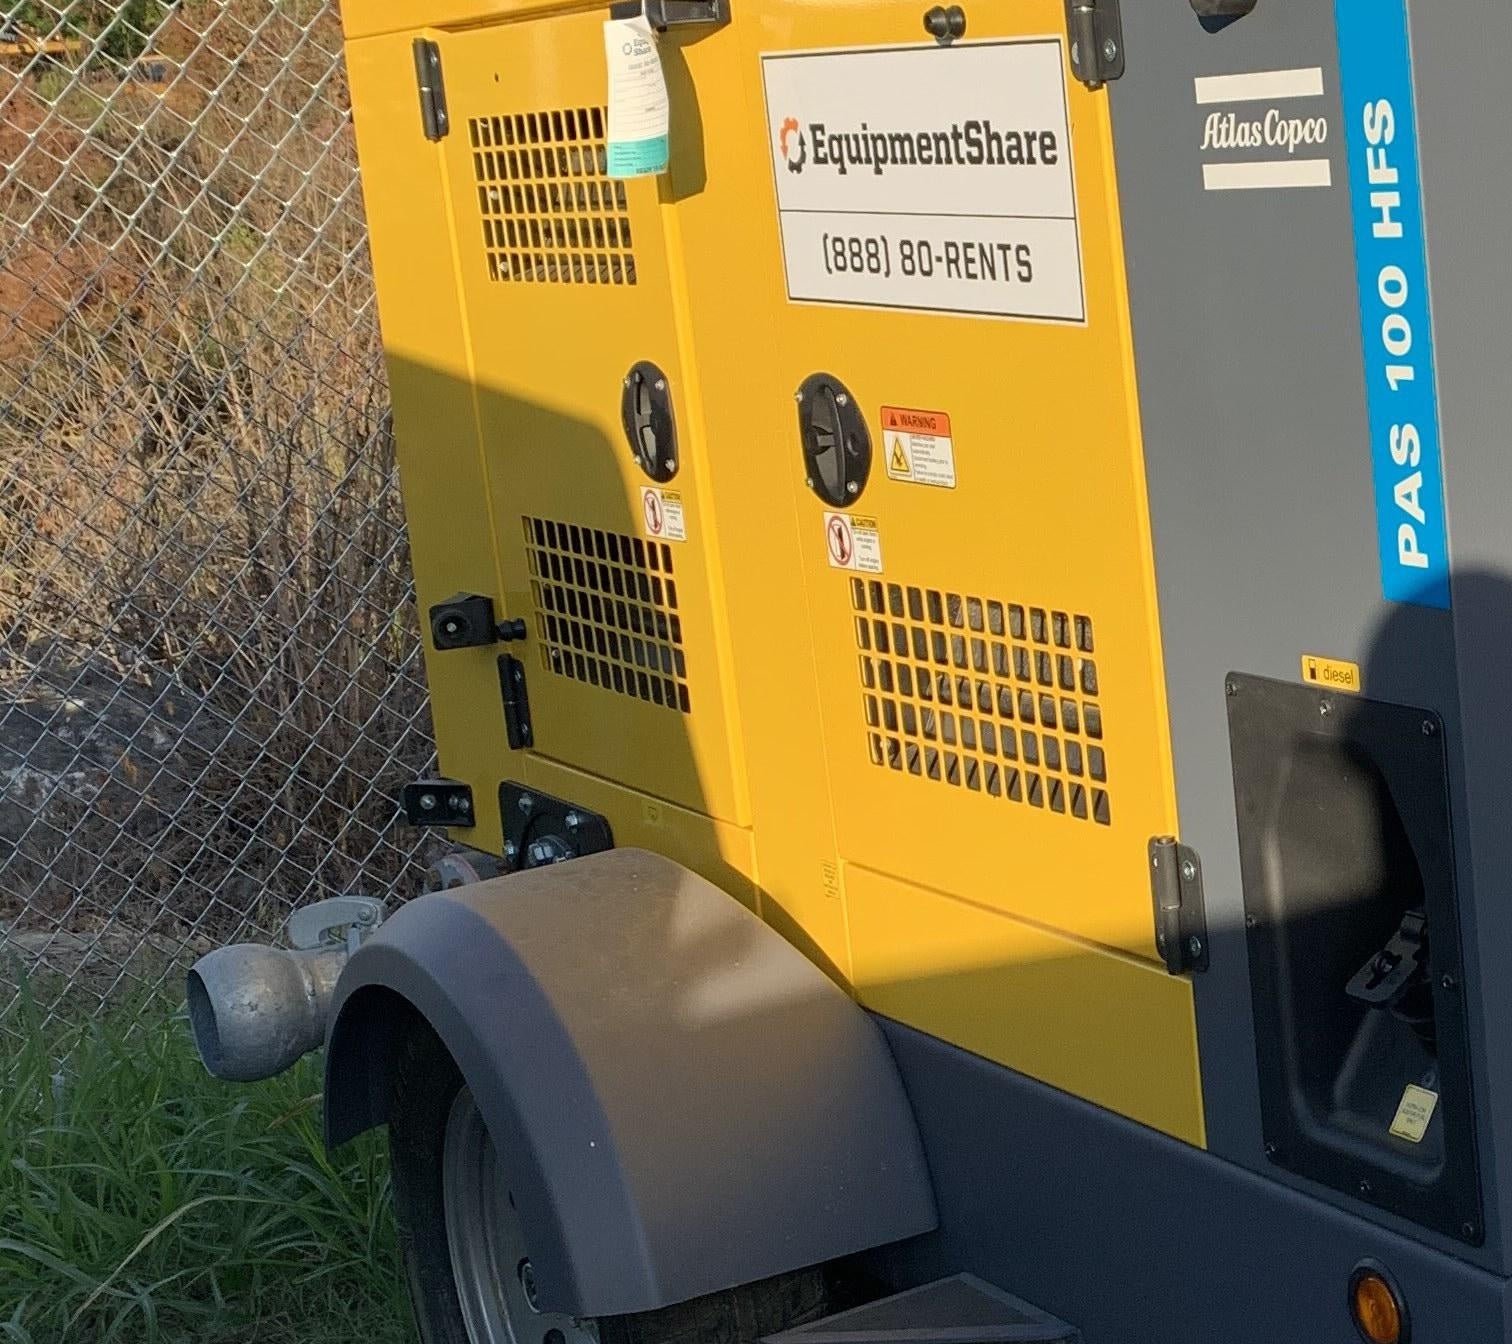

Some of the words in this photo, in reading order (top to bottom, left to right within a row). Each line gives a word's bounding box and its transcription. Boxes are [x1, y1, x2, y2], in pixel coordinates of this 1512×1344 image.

[808, 120, 1059, 175] EquipmentShare
[1199, 112, 1263, 150] Atlas
[1263, 108, 1328, 154] Copco
[1362, 97, 1404, 239] HFS
[822, 232, 892, 278] (888)
[899, 239, 1034, 283] 80-RENTS
[1376, 264, 1416, 392] 100
[898, 414, 937, 430] WARNING
[1389, 423, 1430, 570] PAS
[1323, 663, 1354, 684] diesel
